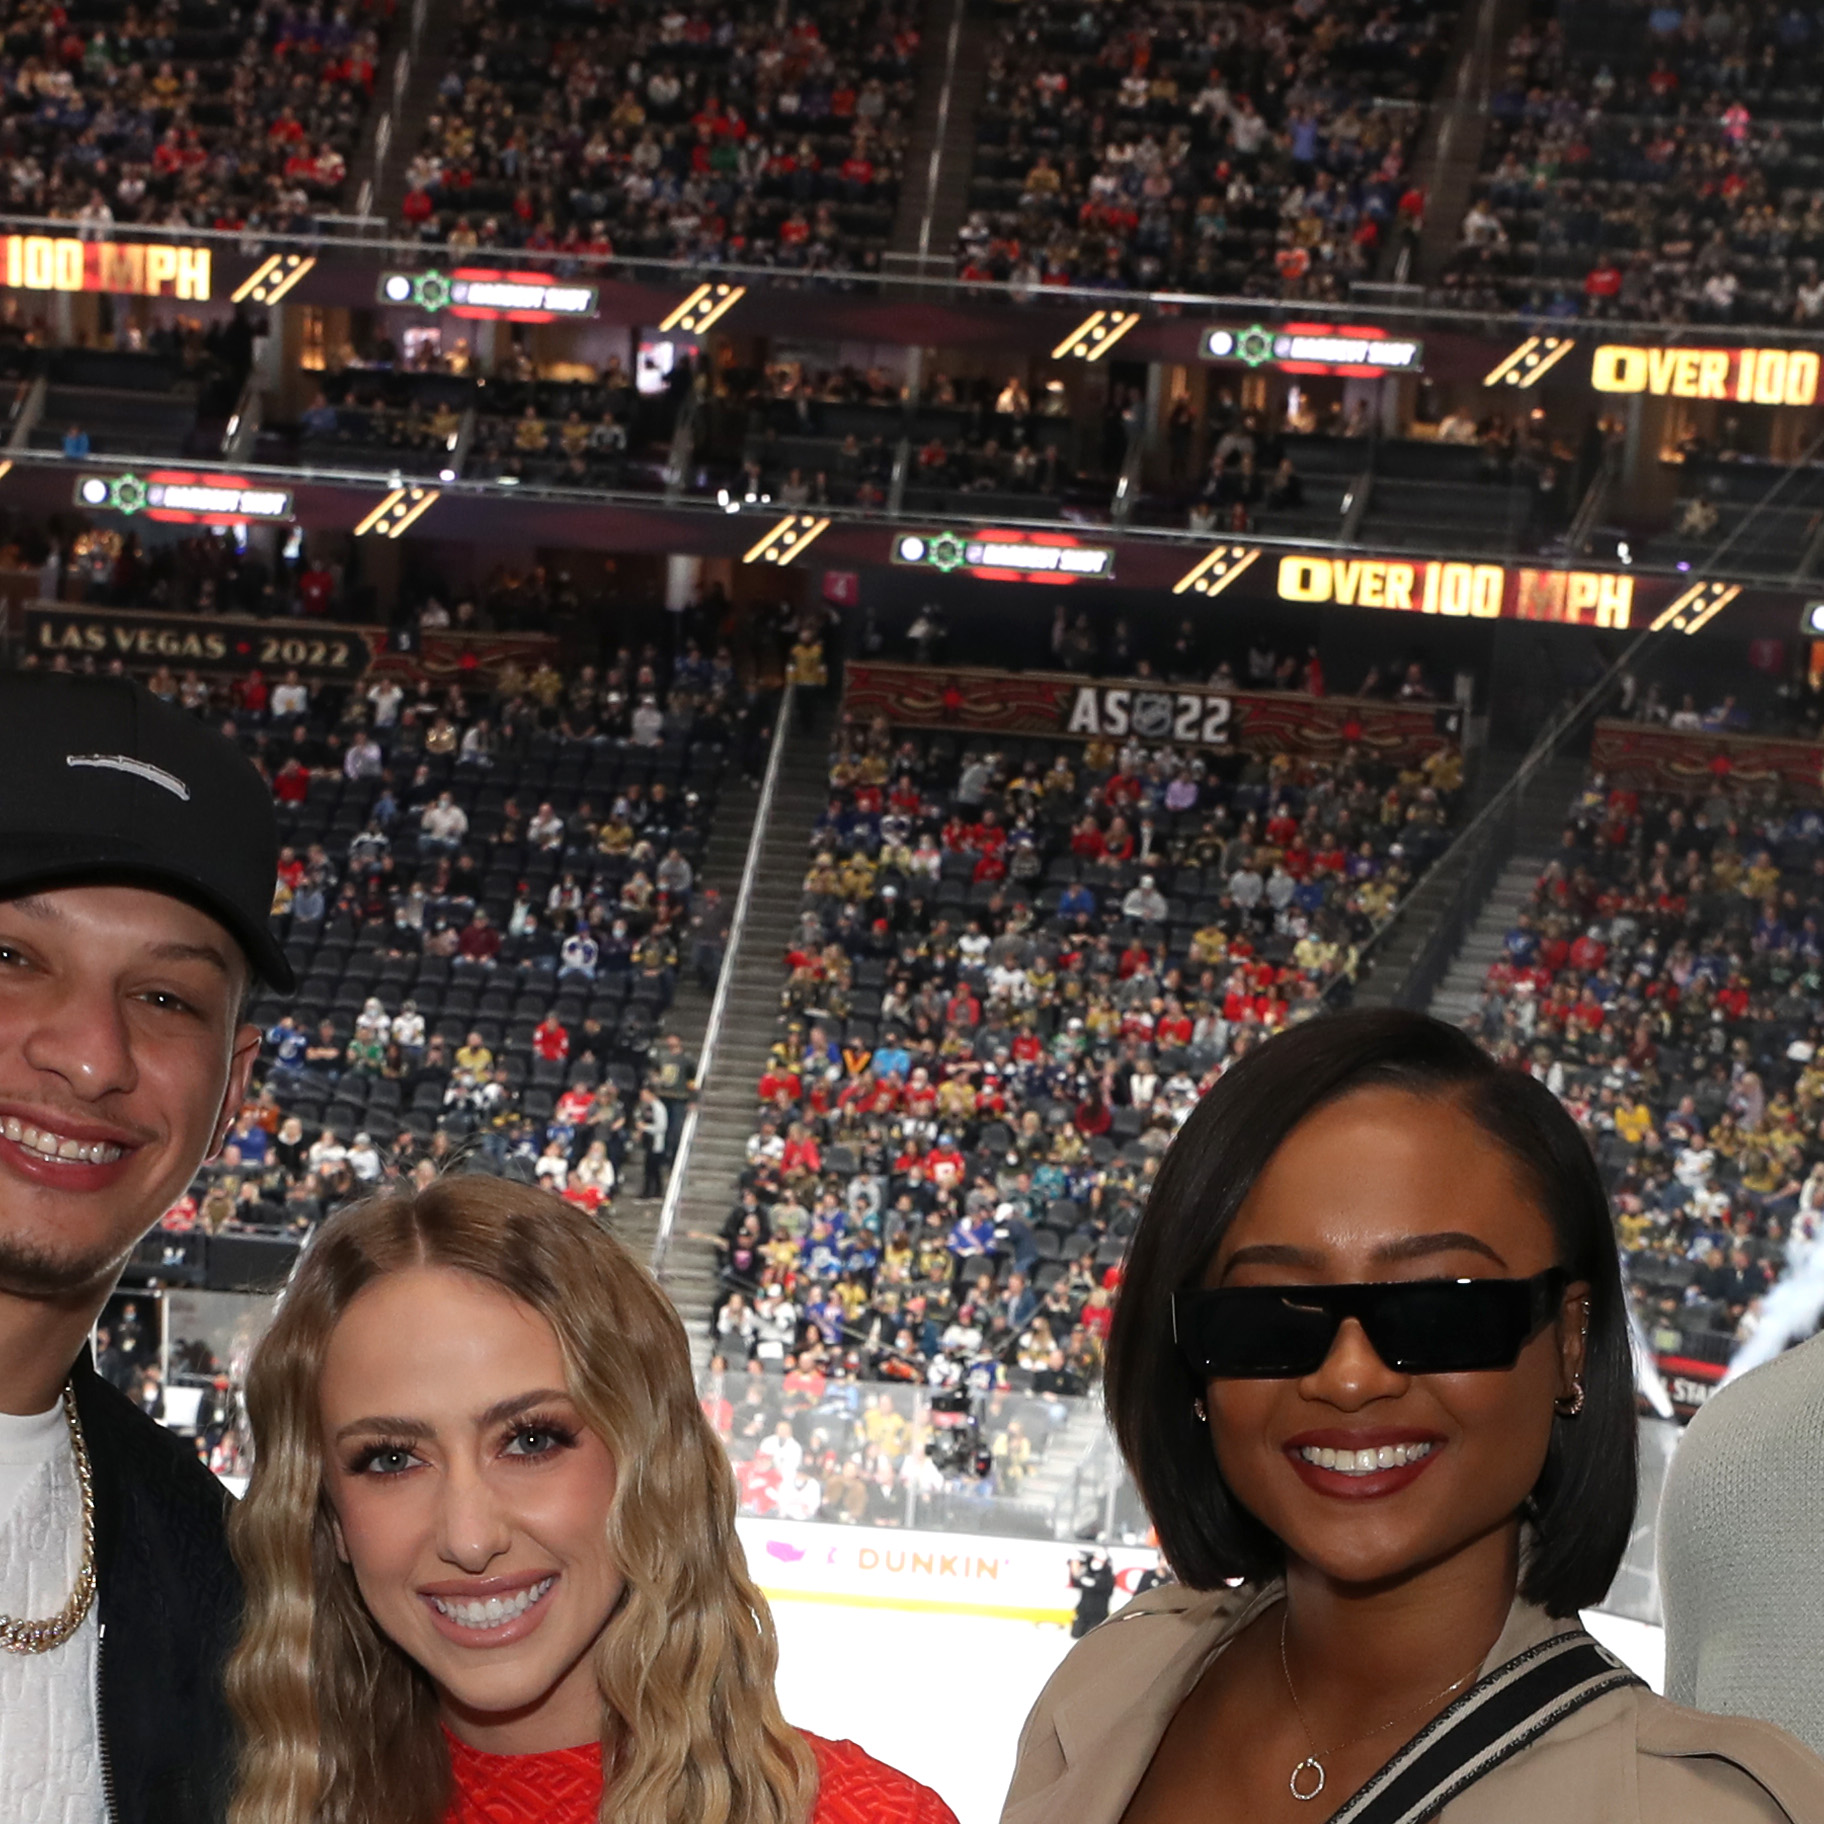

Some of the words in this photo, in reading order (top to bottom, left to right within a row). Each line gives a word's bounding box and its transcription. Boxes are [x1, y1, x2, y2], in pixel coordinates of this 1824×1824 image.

[6, 235, 84, 291] 100
[98, 242, 211, 301] MPH
[1591, 345, 1729, 399] OVER
[1736, 349, 1821, 405] 100
[1277, 555, 1415, 610] OVER
[1421, 561, 1505, 618] 100
[1517, 568, 1634, 629] MPH
[39, 622, 107, 651] LAS
[113, 626, 227, 660] VEGAS
[259, 636, 350, 668] 2022
[1067, 687, 1132, 736] AS
[1174, 695, 1232, 743] 22
